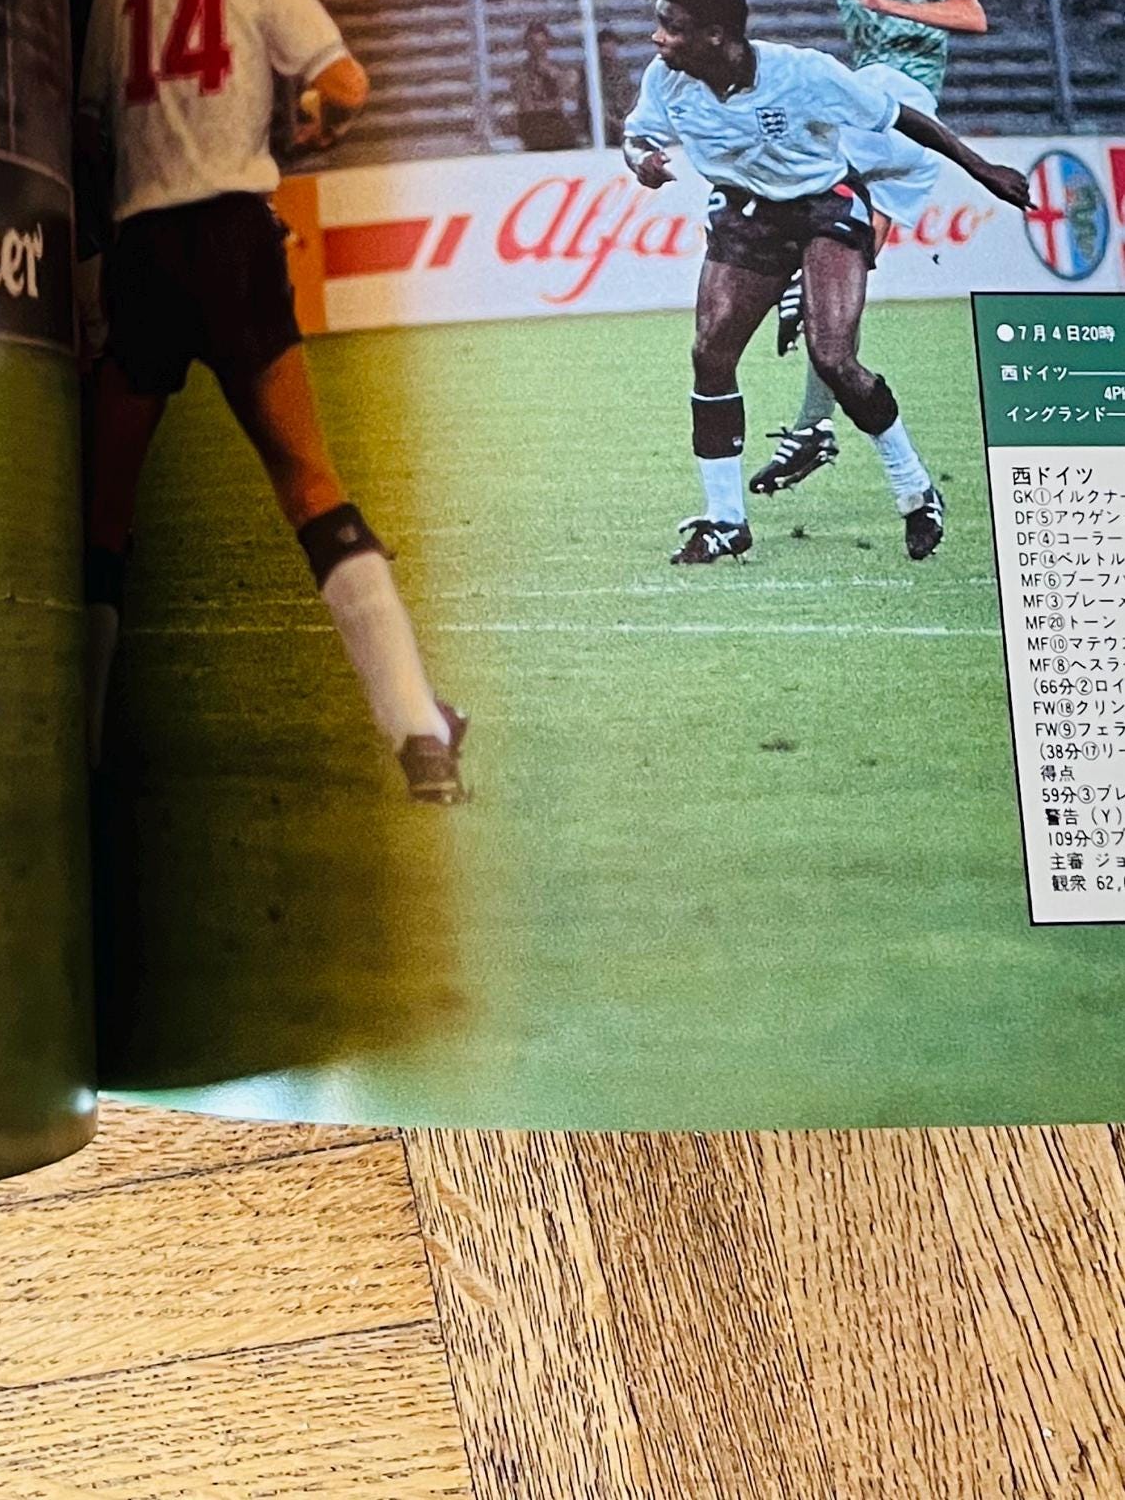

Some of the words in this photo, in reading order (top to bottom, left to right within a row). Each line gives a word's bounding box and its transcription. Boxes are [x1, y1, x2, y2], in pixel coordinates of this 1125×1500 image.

[495, 173, 691, 306] Alfa
[1000, 364, 1068, 382] 西ドイツ
[1006, 405, 1106, 423] イングランド
[1011, 466, 1093, 486] 西ドイツ
[1027, 634, 1125, 654] MF⑩マテウ
[1029, 655, 1125, 675] MF⑧ヘスラ
[1040, 764, 1075, 782] 得点
[1096, 875, 1125, 892] 62,
